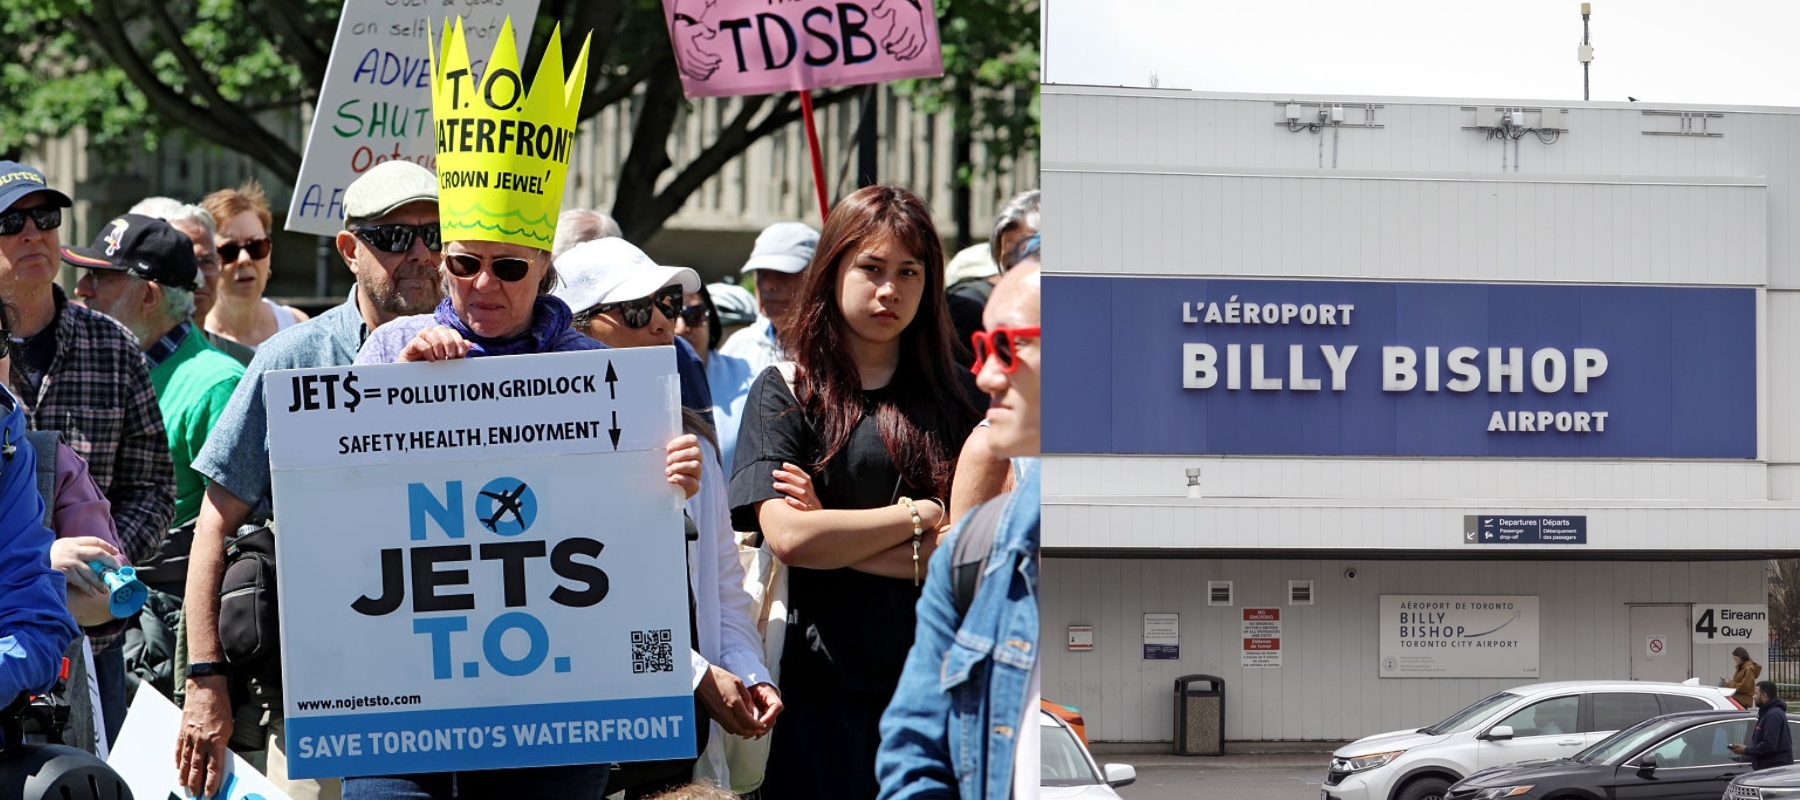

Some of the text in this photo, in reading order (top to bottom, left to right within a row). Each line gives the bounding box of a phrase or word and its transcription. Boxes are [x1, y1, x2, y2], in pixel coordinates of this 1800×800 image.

[352, 22, 377, 35] on
[719, 3, 877, 72] TDSB
[436, 118, 573, 164] ATERFRONT
[1182, 295, 1354, 325] L'AÉROPORT
[1182, 342, 1608, 393] BILLY BISHOP
[1487, 411, 1608, 432] AIRPORT
[408, 477, 538, 540] NO
[1543, 519, 1570, 527] Départs
[351, 537, 610, 616] JETS
[1400, 601, 1514, 610] AÉROPORT DE TORONTO
[1400, 612, 1446, 624] BILLY
[1400, 626, 1465, 638] BISHOP
[1695, 608, 1766, 639] 4 Eireann
[1721, 626, 1753, 639] Quay
[413, 611, 571, 680] T.O.
[1400, 640, 1518, 648] TORONTO CITY AIRPORT
[297, 695, 421, 711] www.nojetsto.com
[298, 715, 683, 759] SAVE TORONTO'S WATERFRONT
